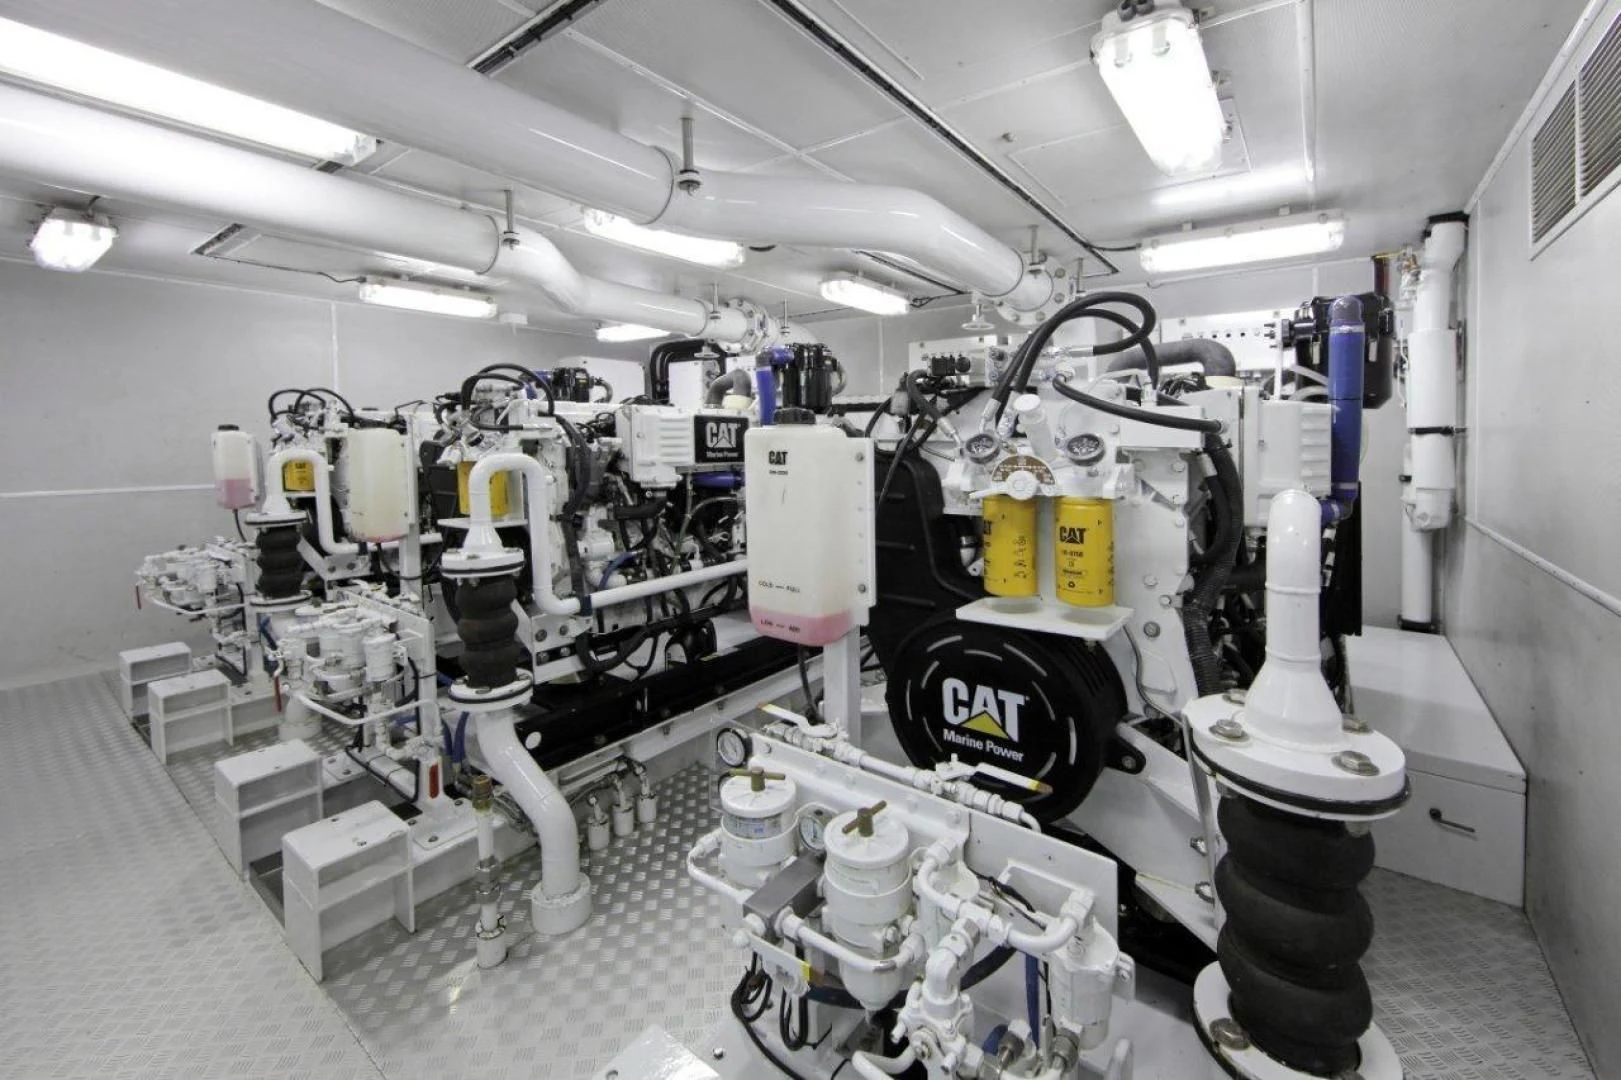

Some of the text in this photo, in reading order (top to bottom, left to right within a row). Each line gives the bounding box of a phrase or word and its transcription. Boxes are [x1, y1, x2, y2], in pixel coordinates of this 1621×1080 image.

[705, 422, 738, 448] CAT
[768, 450, 788, 465] CAT
[1059, 526, 1086, 545] CAT
[758, 580, 773, 589] COLD
[942, 677, 1026, 743] CAT
[943, 728, 1025, 763] Marine Power
